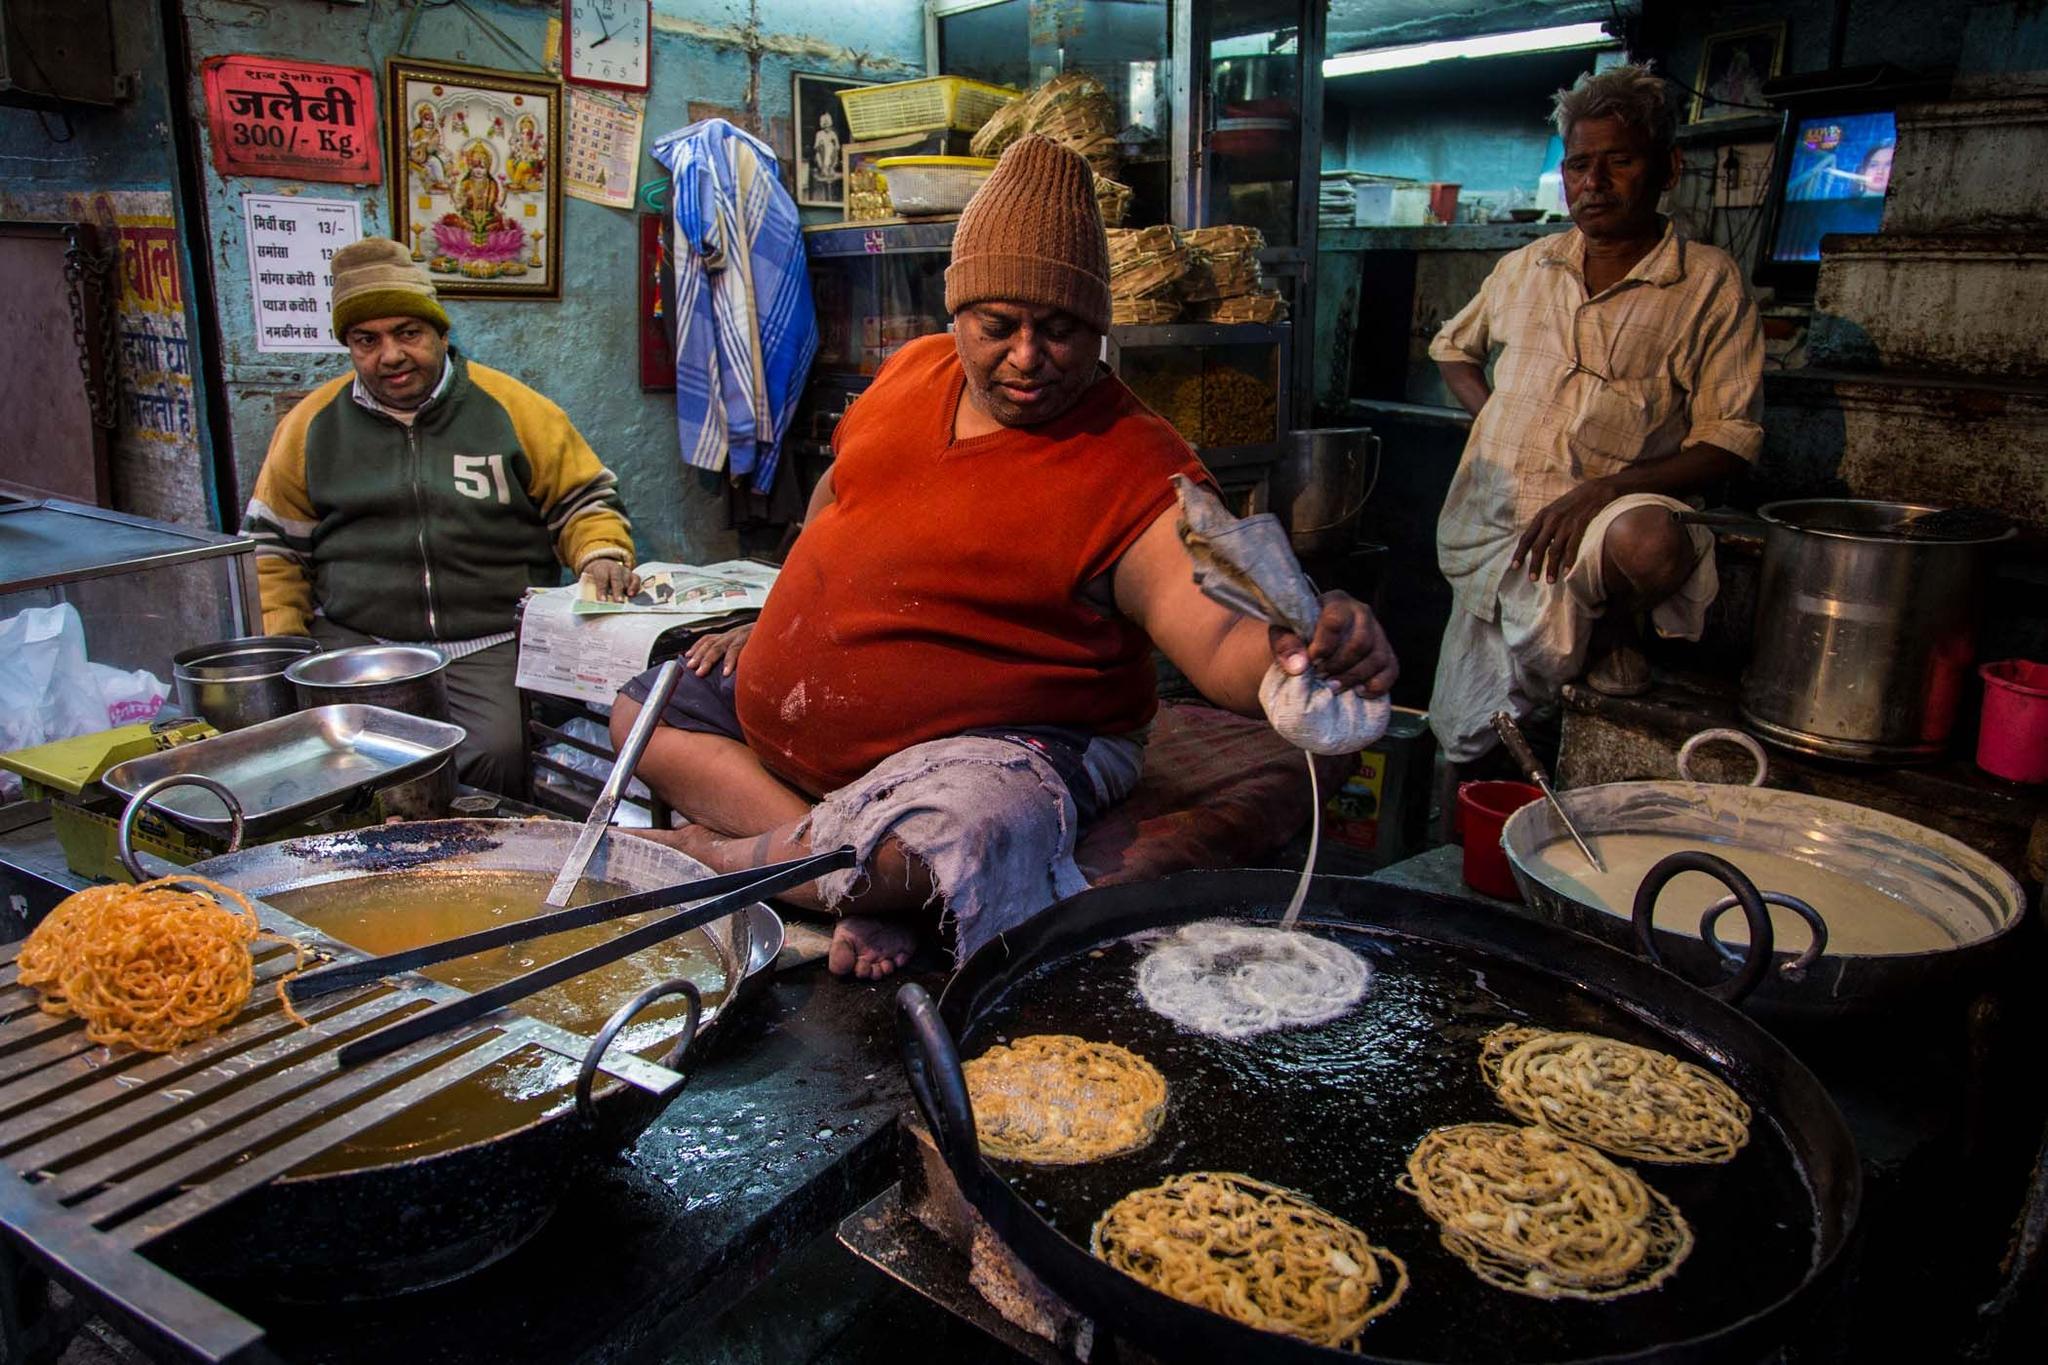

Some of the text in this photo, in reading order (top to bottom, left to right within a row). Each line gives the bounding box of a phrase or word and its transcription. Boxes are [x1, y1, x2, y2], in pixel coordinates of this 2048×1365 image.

[633, 17, 640, 29] 2
[573, 27, 581, 39] 9
[633, 36, 640, 48] 3
[574, 47, 581, 58] 8
[587, 62, 593, 74] 7
[603, 66, 610, 76] 6
[632, 56, 639, 68] 4
[226, 81, 356, 126] जलेबी
[233, 122, 361, 160] 300/- Kg.
[318, 220, 345, 237] 13/-
[265, 322, 302, 339] नमकीन
[453, 454, 511, 504] 51
